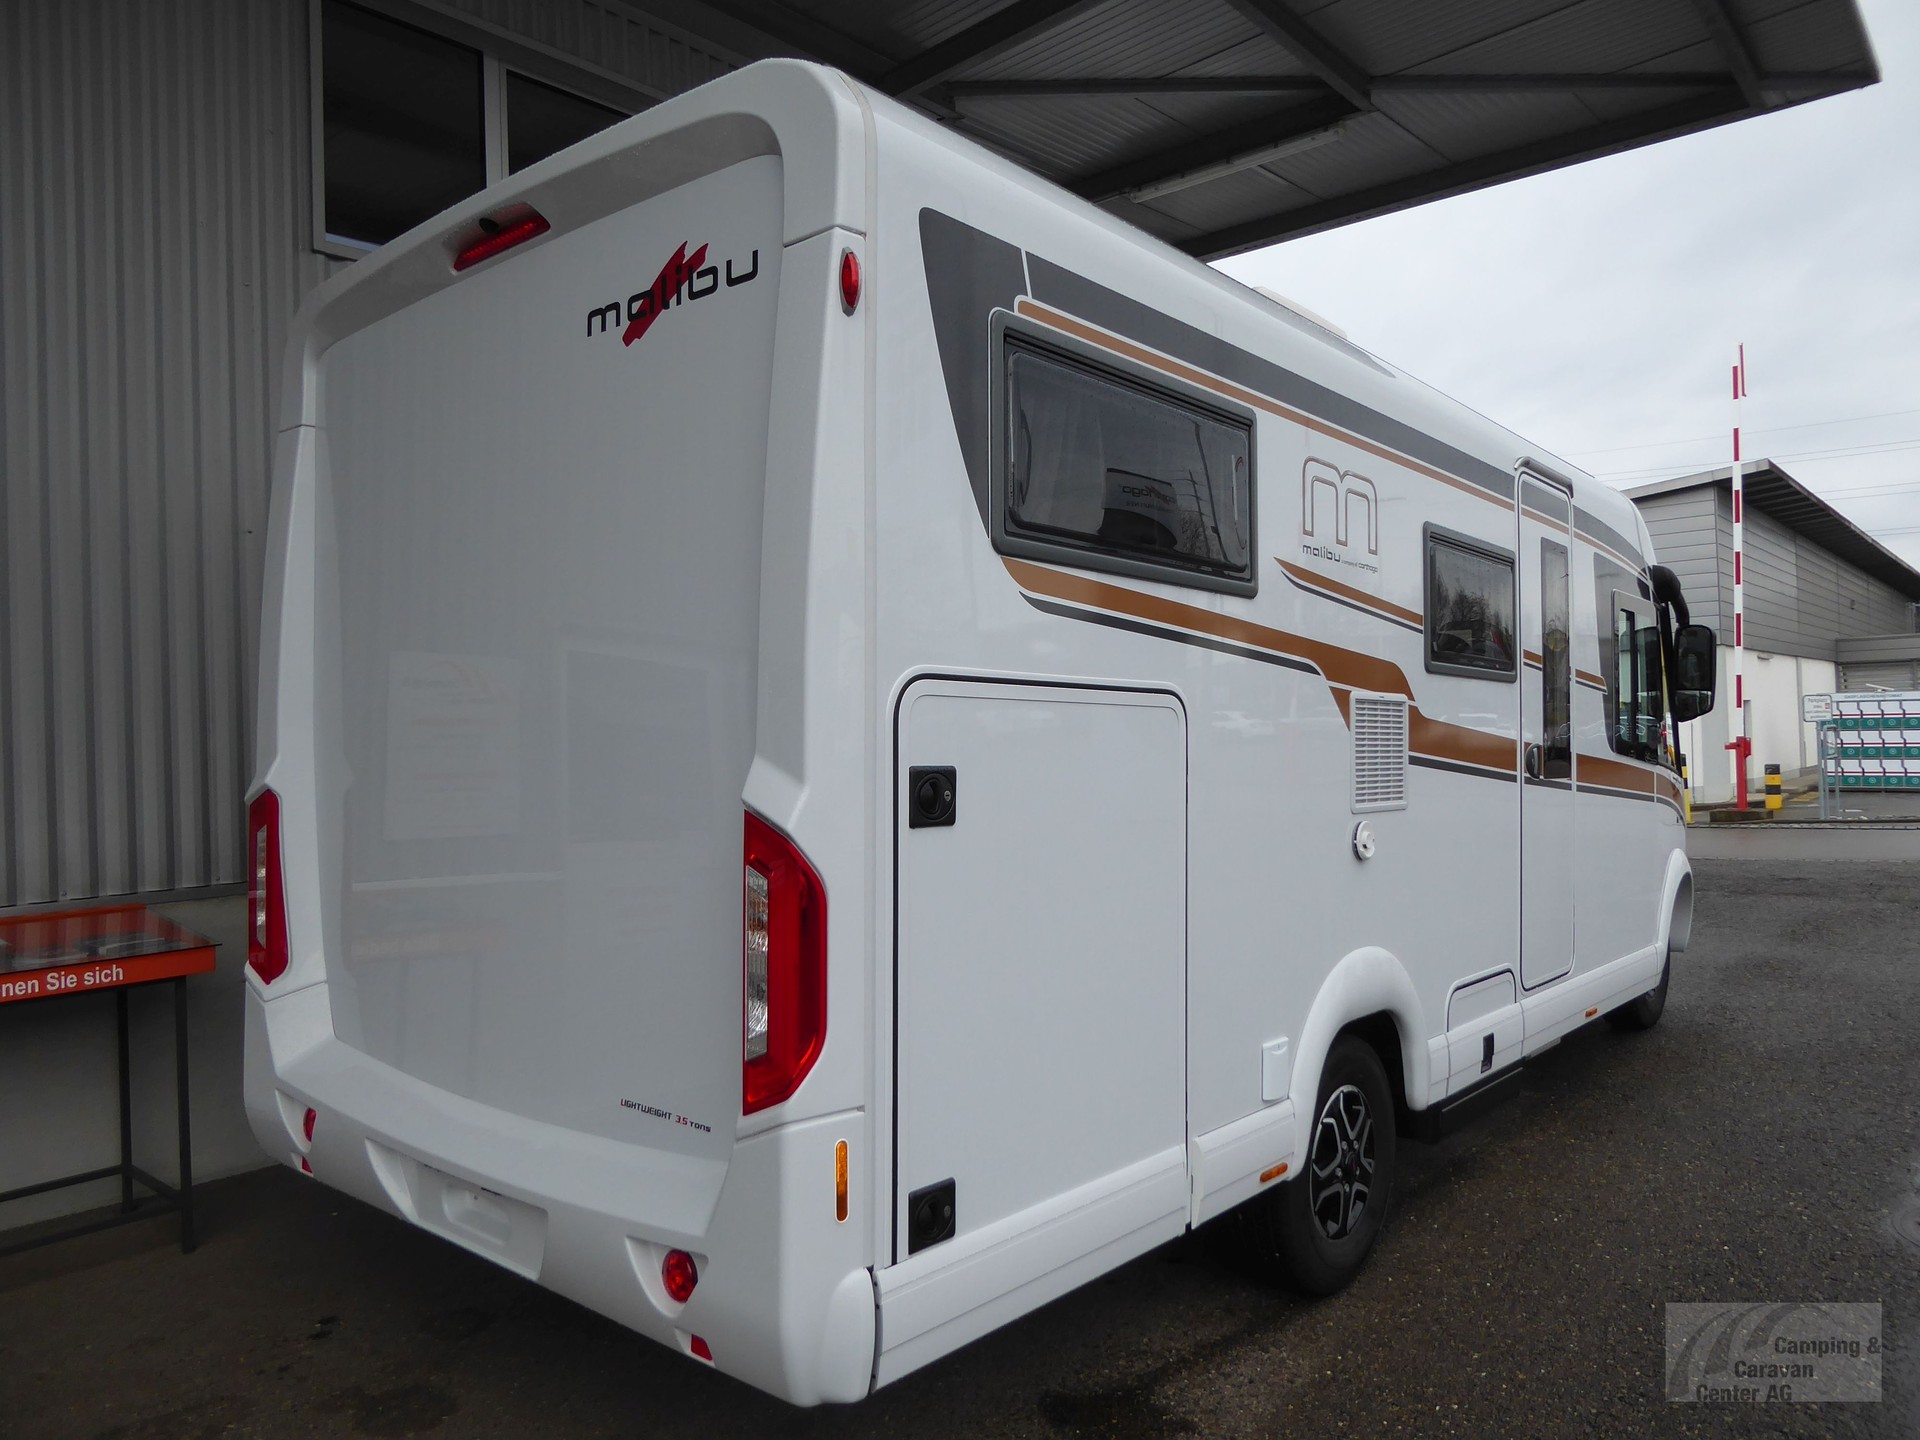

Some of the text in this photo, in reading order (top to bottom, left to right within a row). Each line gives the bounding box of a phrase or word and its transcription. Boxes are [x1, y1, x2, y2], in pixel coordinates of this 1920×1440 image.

[587, 249, 758, 337] malibu
[1302, 544, 1341, 562] malibu
[46, 972, 78, 991] Sie
[83, 964, 124, 985] sich
[620, 1098, 673, 1120] LIGHTWEIGHT
